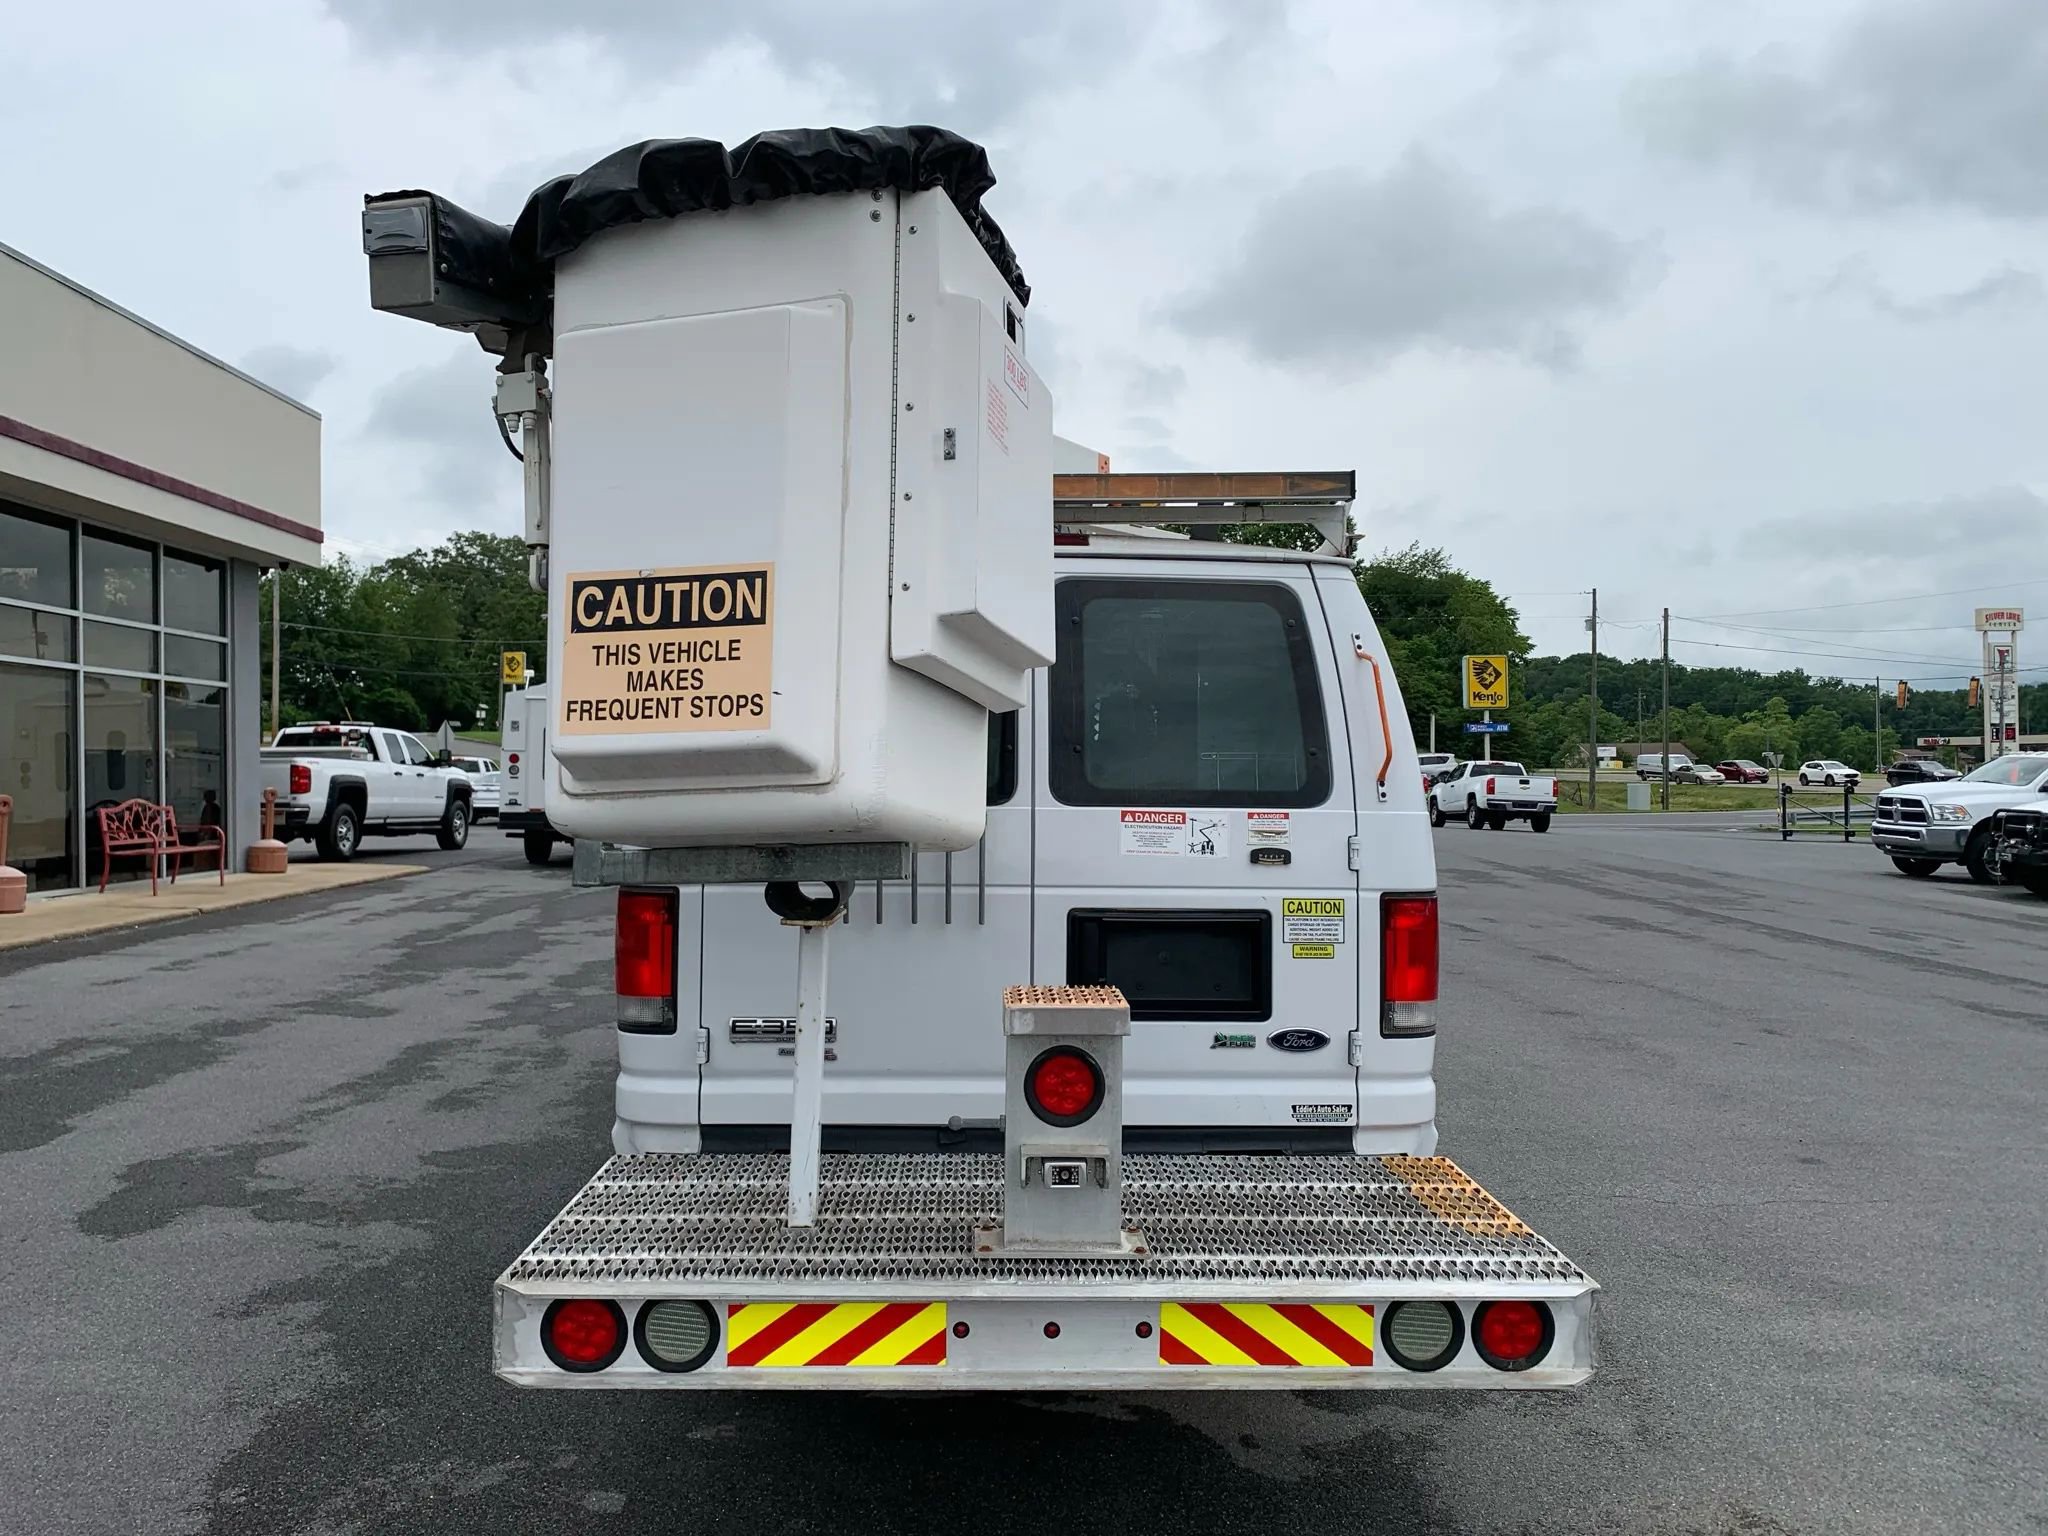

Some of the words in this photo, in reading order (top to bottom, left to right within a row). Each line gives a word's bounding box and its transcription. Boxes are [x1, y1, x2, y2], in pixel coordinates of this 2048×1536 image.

[576, 578, 762, 628] CAUTION
[592, 643, 641, 667] THIS
[648, 639, 742, 664] VEHICLE
[626, 668, 704, 693] MAKES
[1472, 691, 1503, 705] Kenjo
[566, 696, 684, 722] FREQUENT
[690, 693, 764, 719] STOPS
[1135, 812, 1183, 824] DANGER
[1287, 901, 1341, 914] CAUTION
[1283, 1032, 1315, 1048] Ford
[1296, 1104, 1316, 1113] Eddie's
[1317, 1104, 1331, 1113] Auto
[1332, 1104, 1349, 1113] Sales
